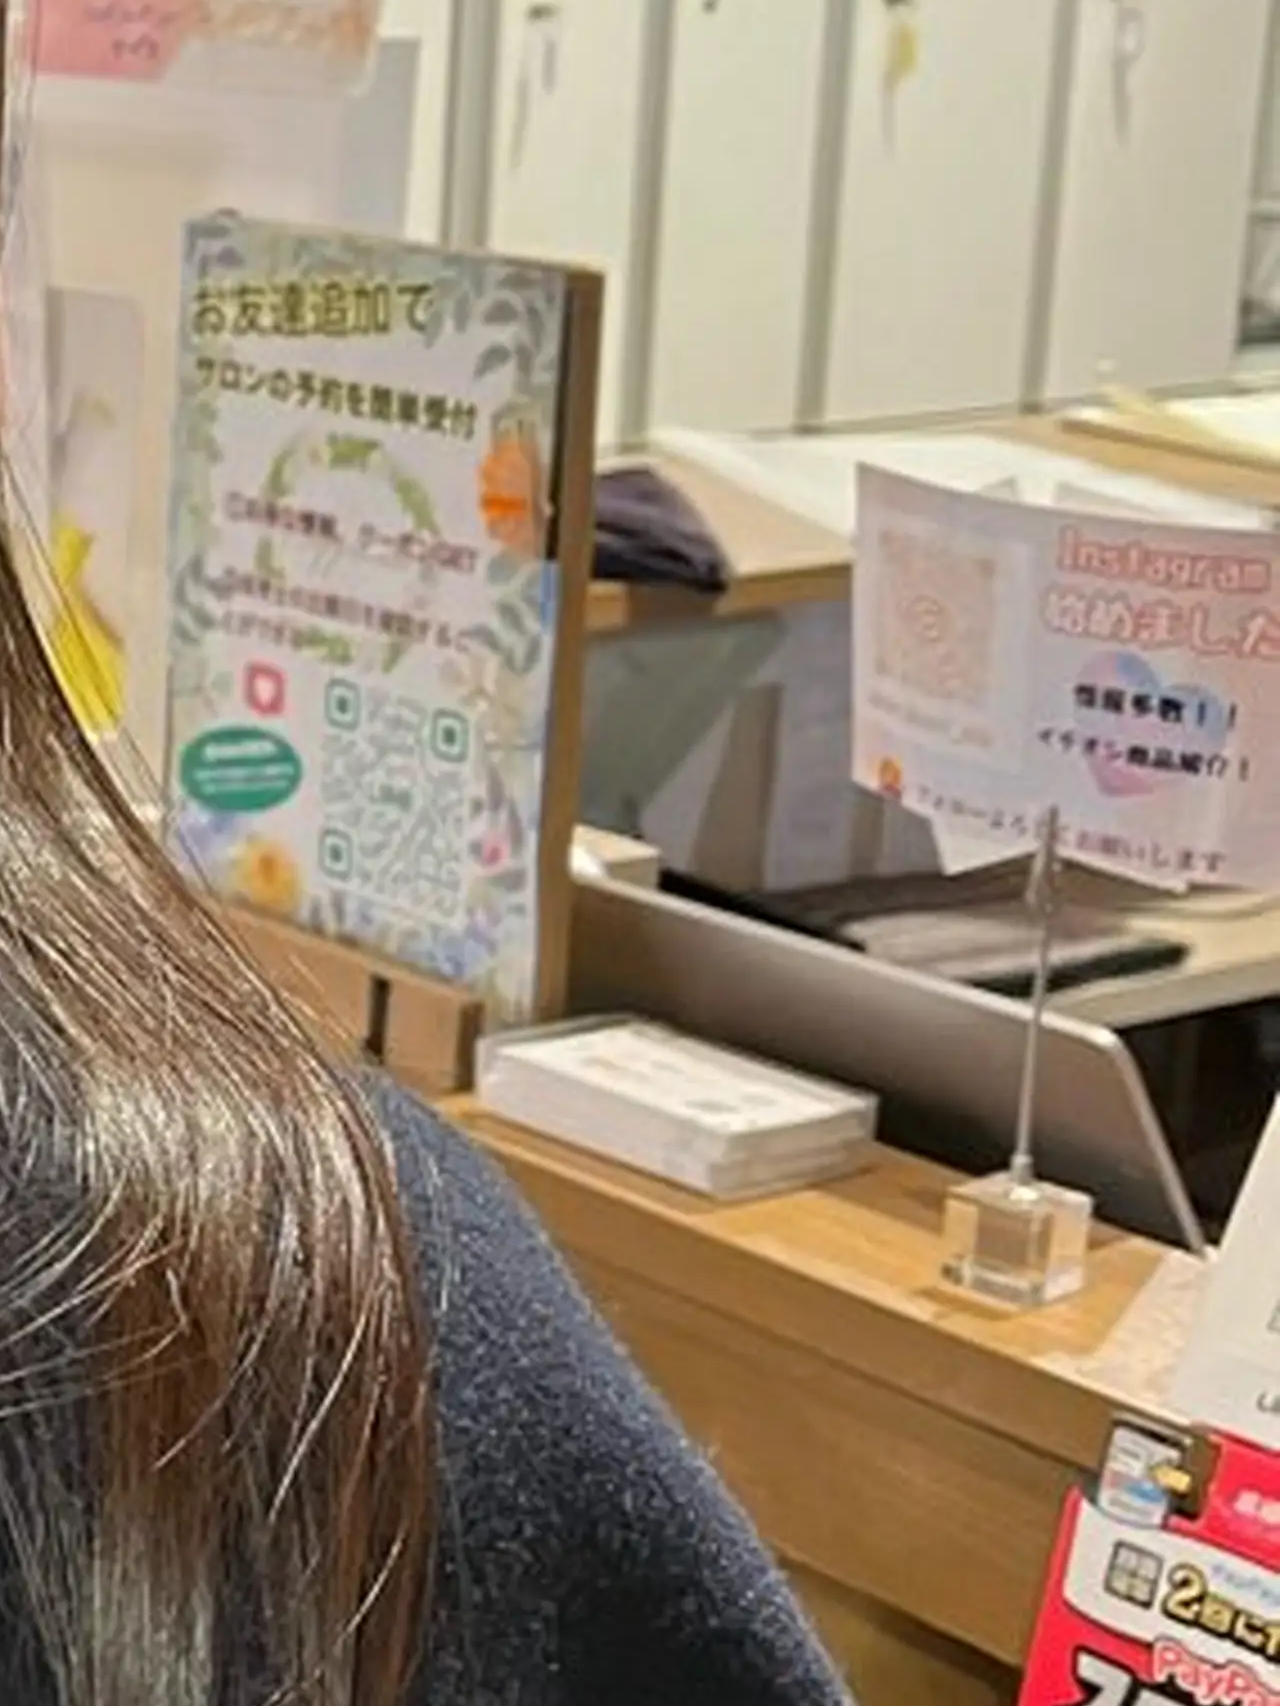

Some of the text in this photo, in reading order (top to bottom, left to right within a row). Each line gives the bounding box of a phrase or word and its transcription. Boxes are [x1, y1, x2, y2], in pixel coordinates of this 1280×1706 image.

[193, 280, 434, 338] お友達追加で
[197, 356, 478, 441] サロンの予約を簡単受付
